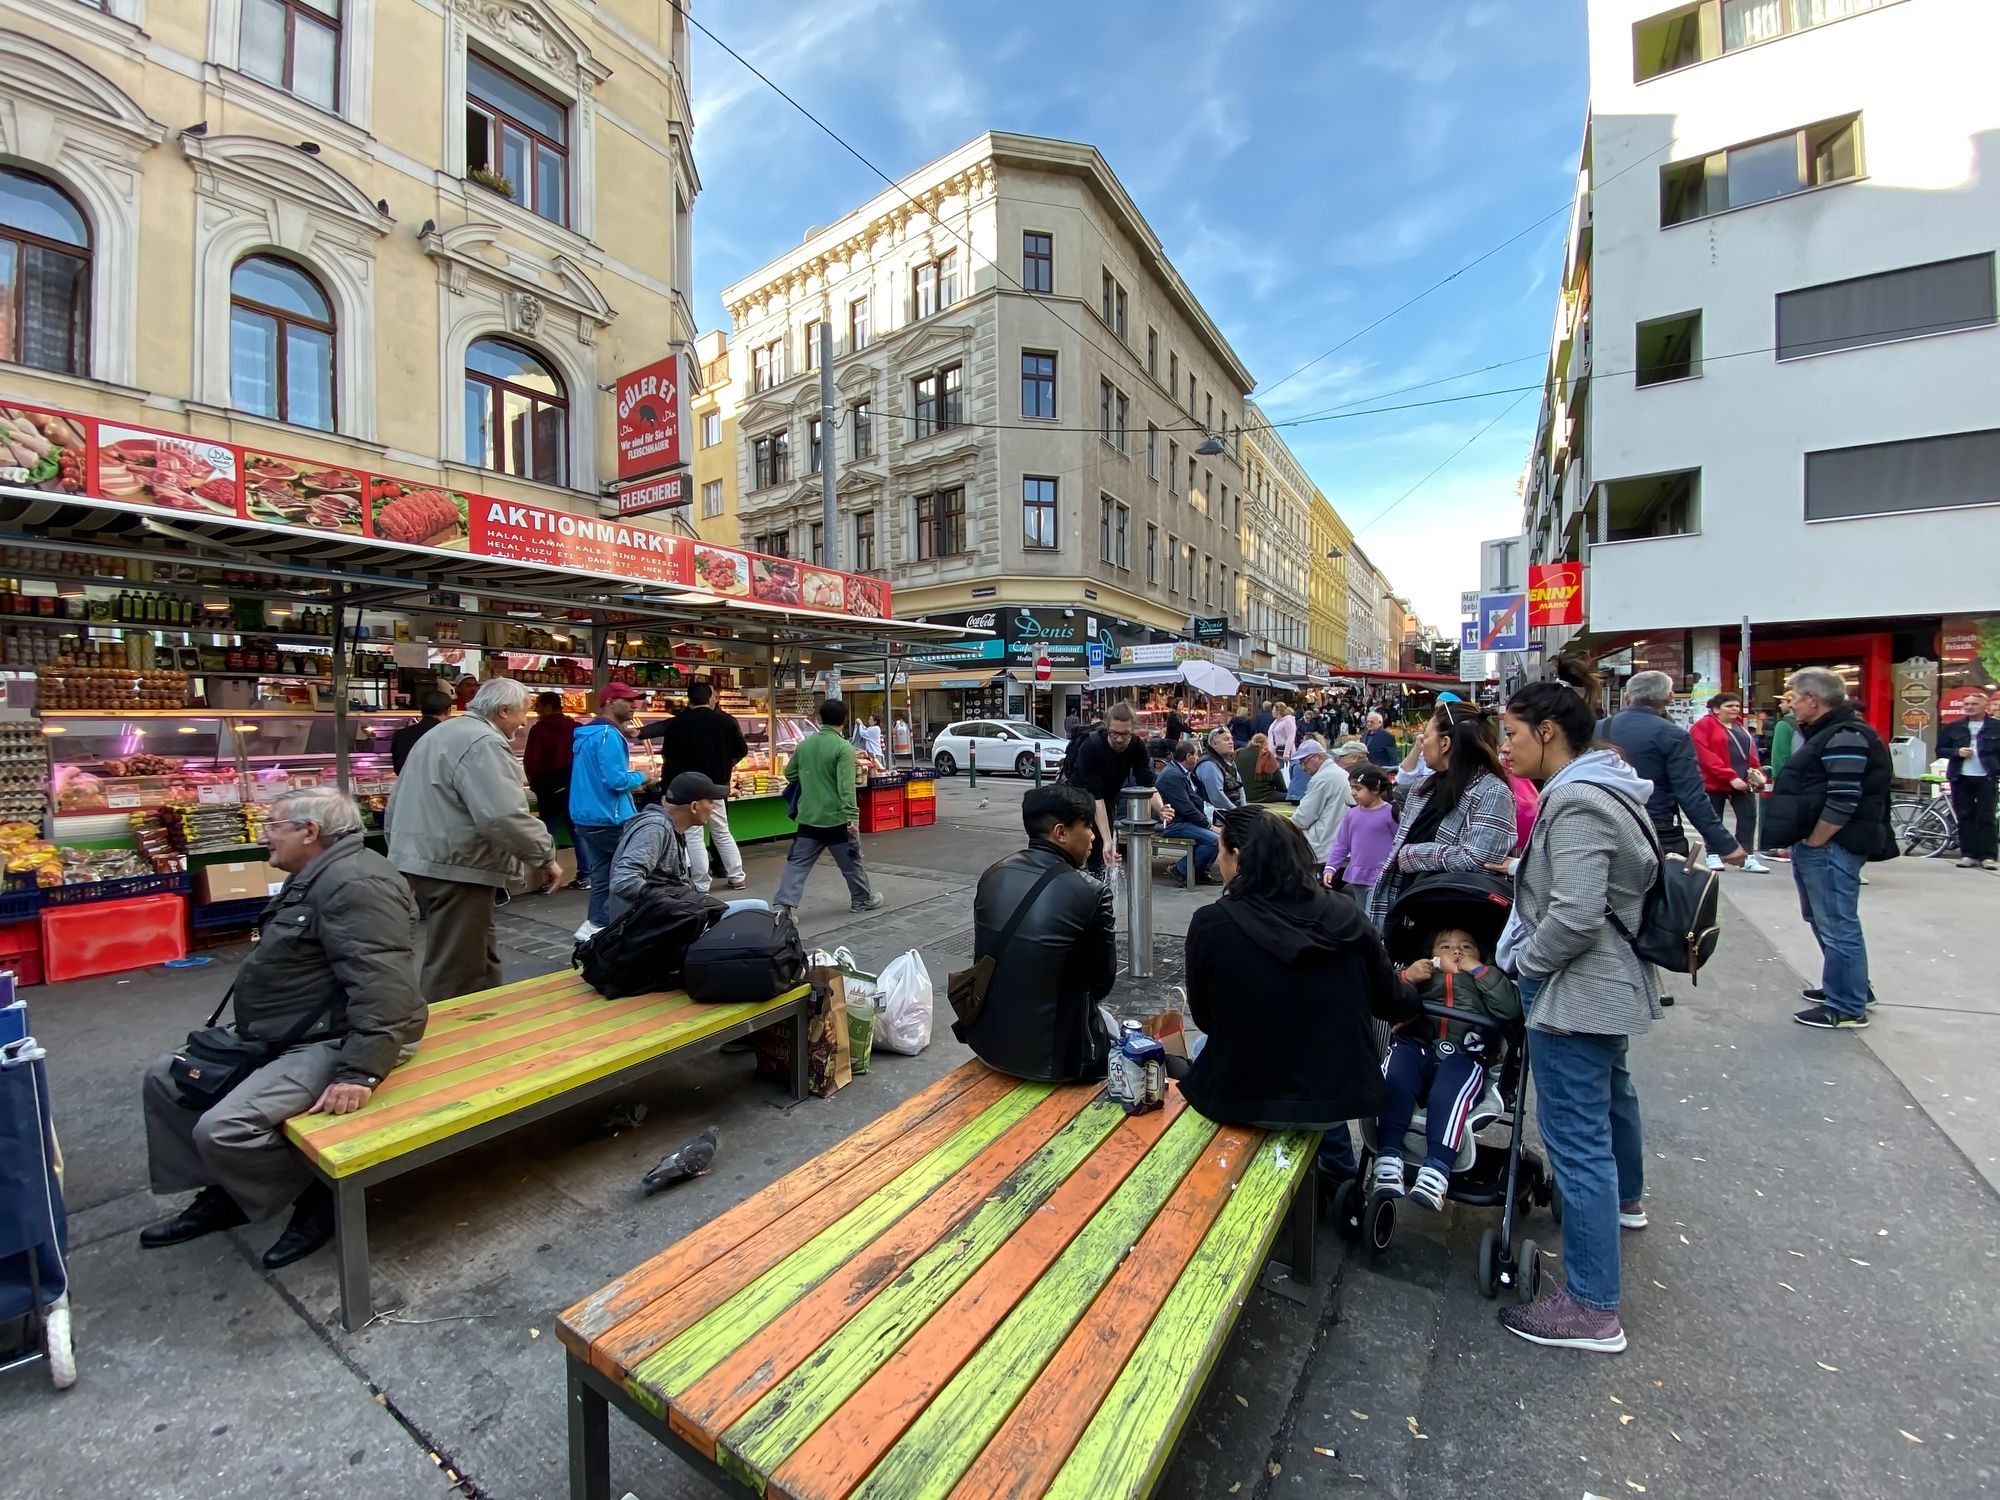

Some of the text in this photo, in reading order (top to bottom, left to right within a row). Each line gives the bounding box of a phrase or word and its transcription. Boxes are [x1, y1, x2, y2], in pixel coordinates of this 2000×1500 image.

[619, 375, 676, 420] GÜLER ET
[620, 438, 631, 451] Wir
[631, 435, 644, 448] sind
[654, 429, 664, 441] Sie
[628, 440, 669, 460] FLEISCHHAUER
[620, 480, 681, 510] FLEISCHEREI
[486, 503, 678, 556] AKTIONMARKT
[487, 530, 526, 542] HALAL
[612, 551, 637, 561] RIND
[640, 556, 679, 568] FLEISCH
[487, 540, 520, 551] HELAL
[525, 546, 552, 556] KUZU
[557, 551, 574, 559] ETI
[587, 556, 612, 565] DANA
[616, 561, 630, 569] ETI
[666, 569, 679, 577] ETI
[1529, 585, 1580, 602] ENNY
[1539, 601, 1570, 610] MARKT
[1014, 616, 1075, 638] Denis
[1945, 643, 1975, 651] frisch.
